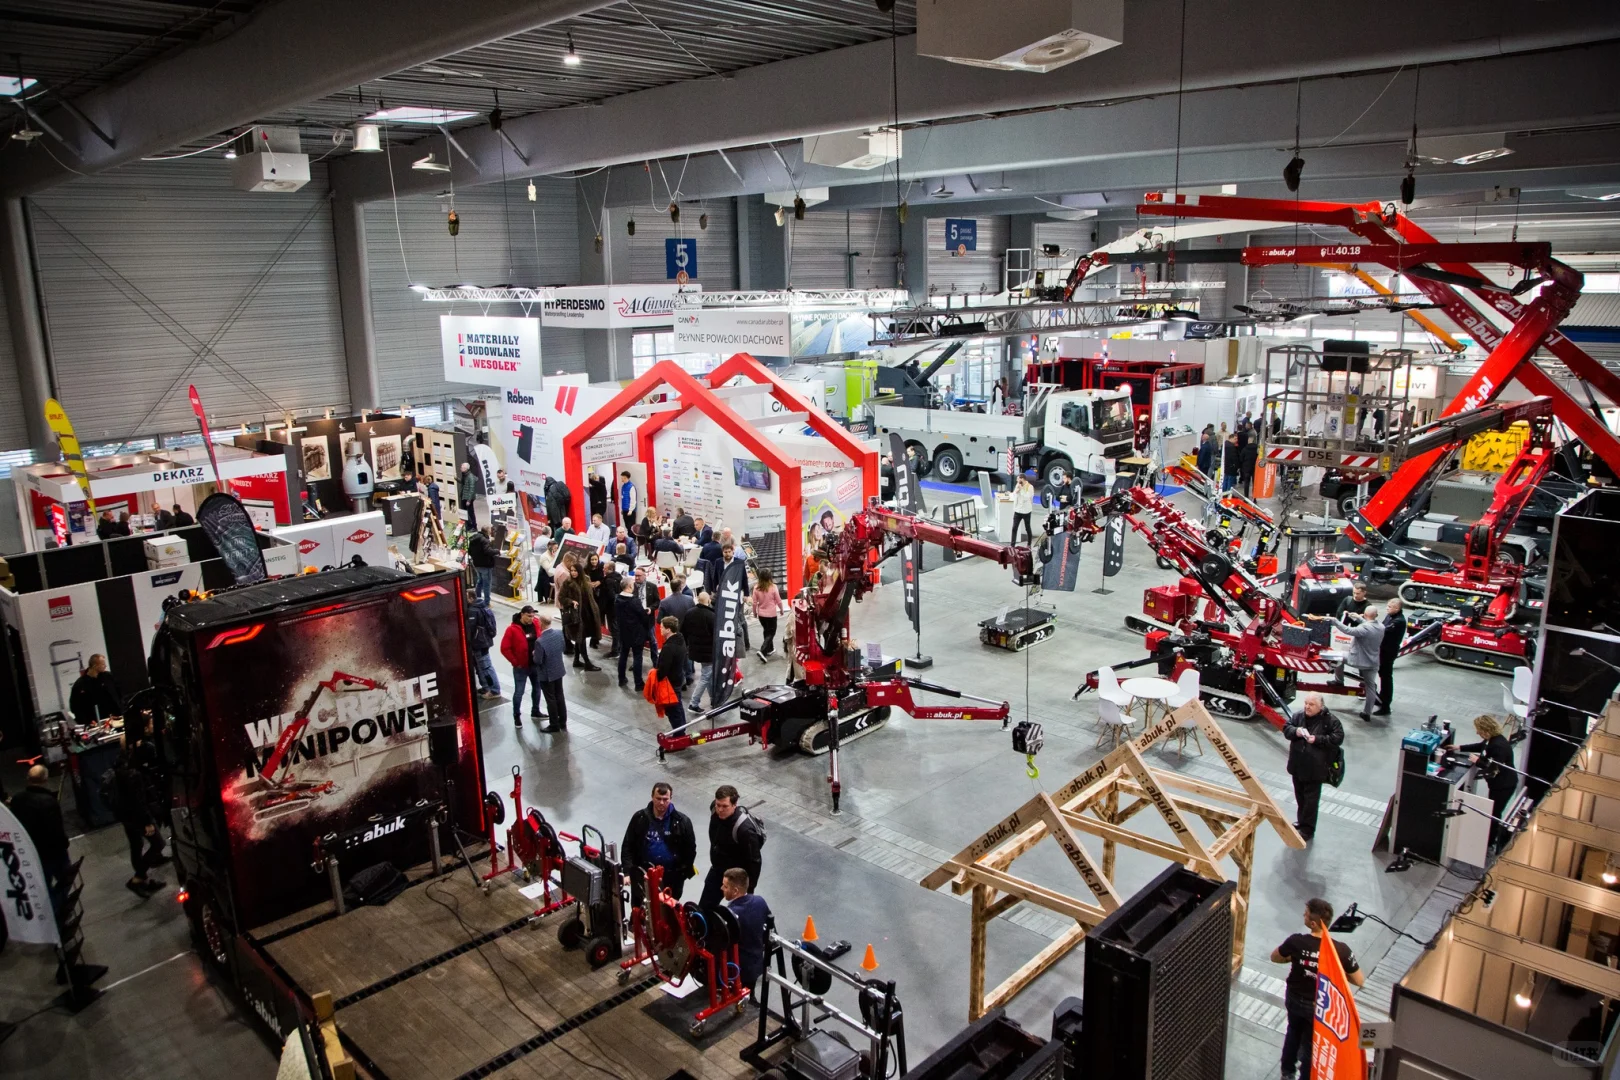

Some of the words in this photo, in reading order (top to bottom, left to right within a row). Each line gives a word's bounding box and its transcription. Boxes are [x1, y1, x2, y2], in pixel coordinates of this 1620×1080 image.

[951, 224, 958, 240] 5
[675, 244, 689, 268] 5
[1268, 248, 1296, 257] abuk.pl
[544, 299, 605, 311] HYPERDESMO
[678, 332, 705, 343] PŁYNNE
[706, 333, 742, 344] POWŁOKI
[742, 335, 784, 346] DACHOWE
[468, 345, 520, 358] BUDOWLANE
[506, 388, 535, 405] Röben
[512, 414, 547, 425] BERGAMO
[1308, 450, 1333, 461] DSE
[153, 467, 204, 482] DEKARZ
[492, 498, 514, 506] Röben
[350, 532, 370, 541] KNIPEX
[718, 579, 740, 658] abuk
[308, 671, 439, 730] CREATE
[932, 711, 963, 720] abuk.pl
[711, 727, 740, 739] abuk.pl
[1140, 714, 1177, 747] abuk.pl
[1212, 737, 1252, 781] abuk.pl
[1069, 759, 1108, 795] abuk.pl
[1146, 786, 1188, 834] abuk.pl
[362, 815, 406, 843] abuk
[982, 812, 1022, 850] abuk.pl
[1063, 842, 1110, 897] abuk.pl
[255, 999, 283, 1037] abuk
[1362, 1029, 1377, 1038] 25
